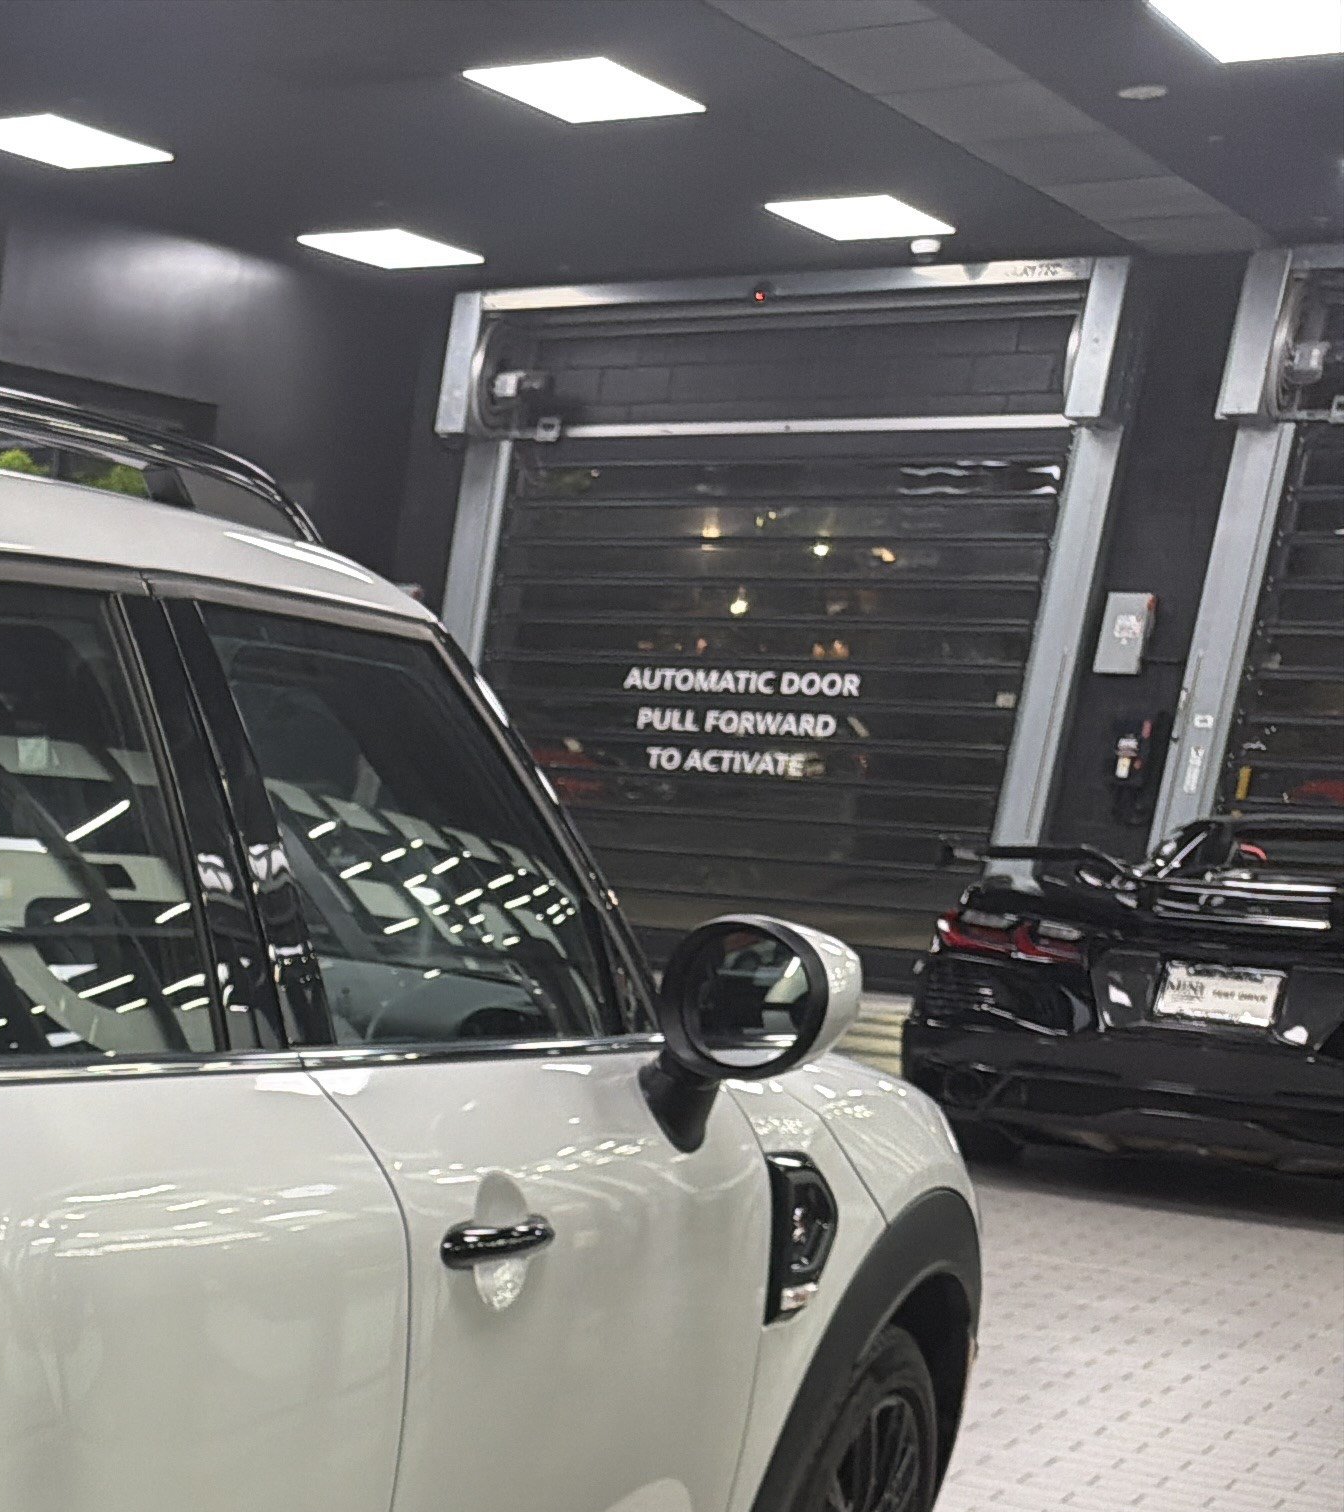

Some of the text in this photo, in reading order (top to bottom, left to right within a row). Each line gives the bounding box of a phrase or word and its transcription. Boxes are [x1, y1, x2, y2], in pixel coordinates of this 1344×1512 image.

[623, 667, 861, 697] AUTOMATIC DOOR
[636, 707, 837, 737] PULL FORWARD
[646, 747, 806, 776] TO ACTIVATE
